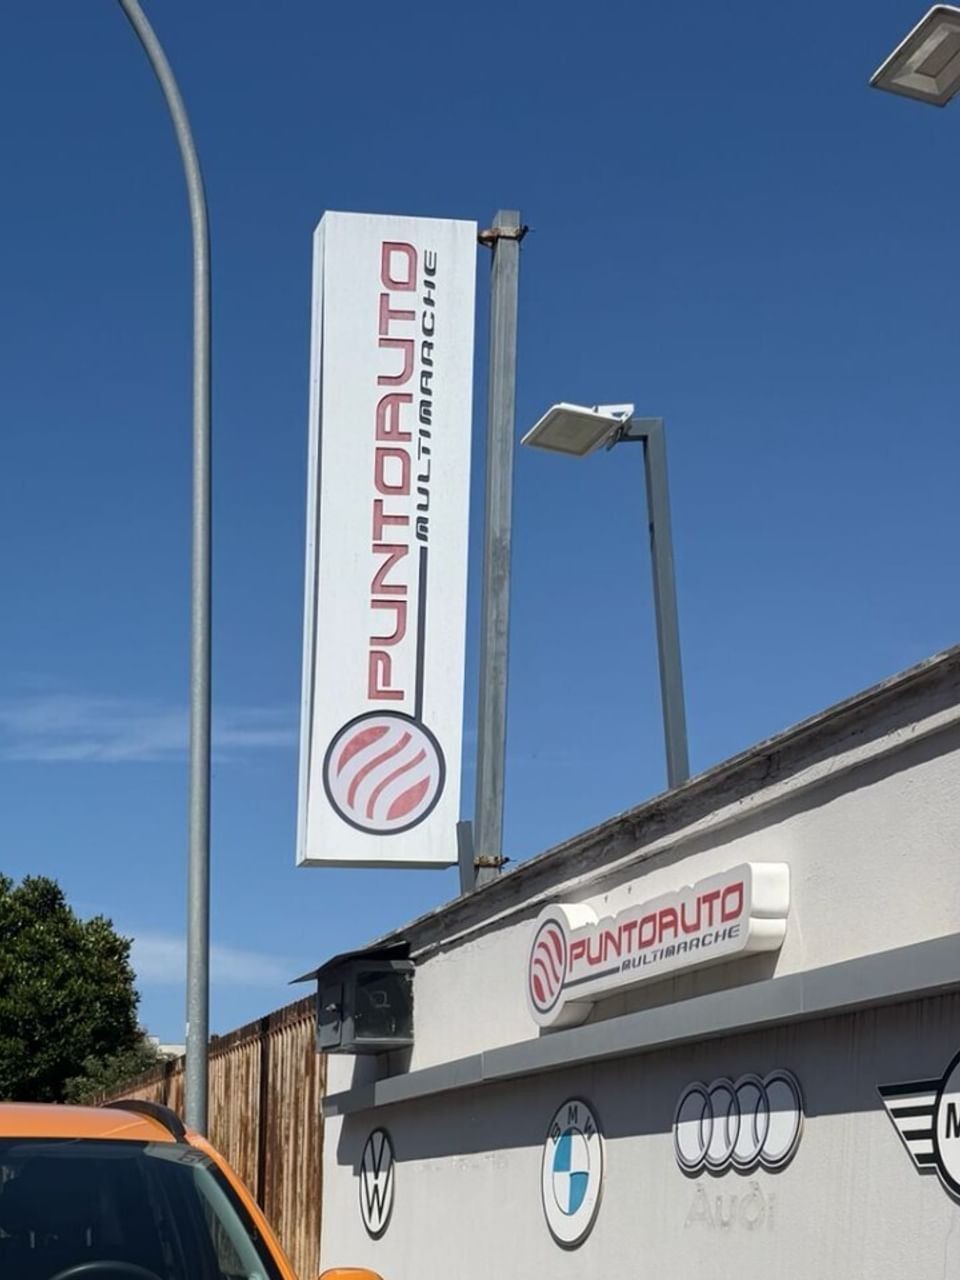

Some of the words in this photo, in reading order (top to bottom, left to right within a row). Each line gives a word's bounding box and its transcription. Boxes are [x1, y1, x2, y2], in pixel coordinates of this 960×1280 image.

[415, 249, 437, 543] MULTIMARCHE
[367, 240, 420, 700] PUNTOAUTO
[569, 880, 744, 972] PUNTOAUTO
[621, 924, 741, 972] MULTIMARCHE
[551, 1104, 595, 1146] BMW
